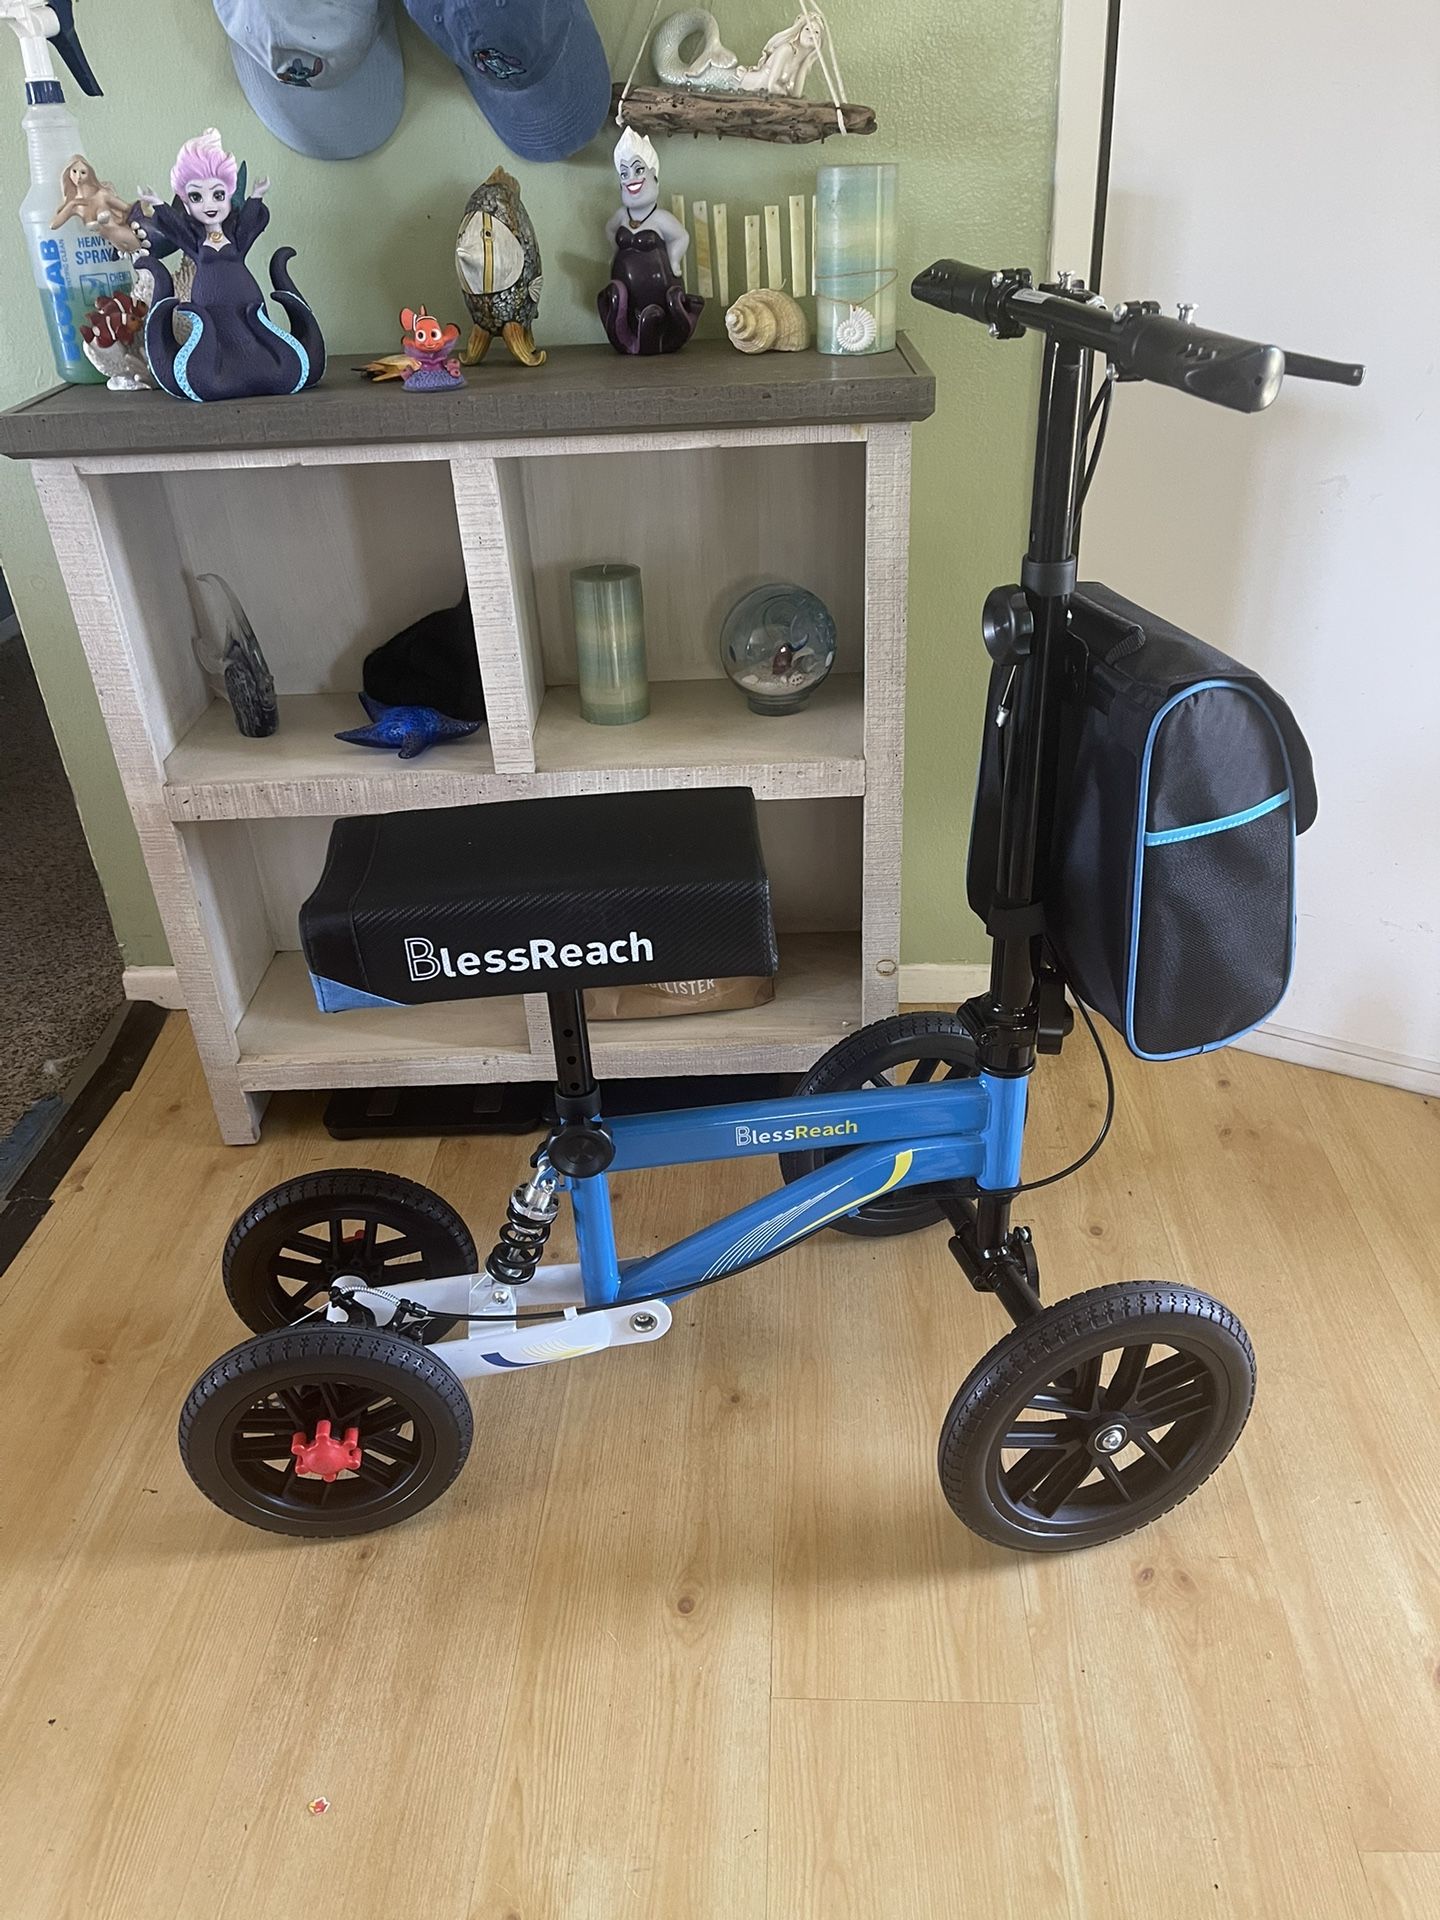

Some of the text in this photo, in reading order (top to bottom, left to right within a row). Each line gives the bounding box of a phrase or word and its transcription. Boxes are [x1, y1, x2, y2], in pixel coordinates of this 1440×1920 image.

[404, 931, 654, 982] BlessReach
[642, 979, 715, 995] LLISTER
[735, 1120, 858, 1147] BlessReach
